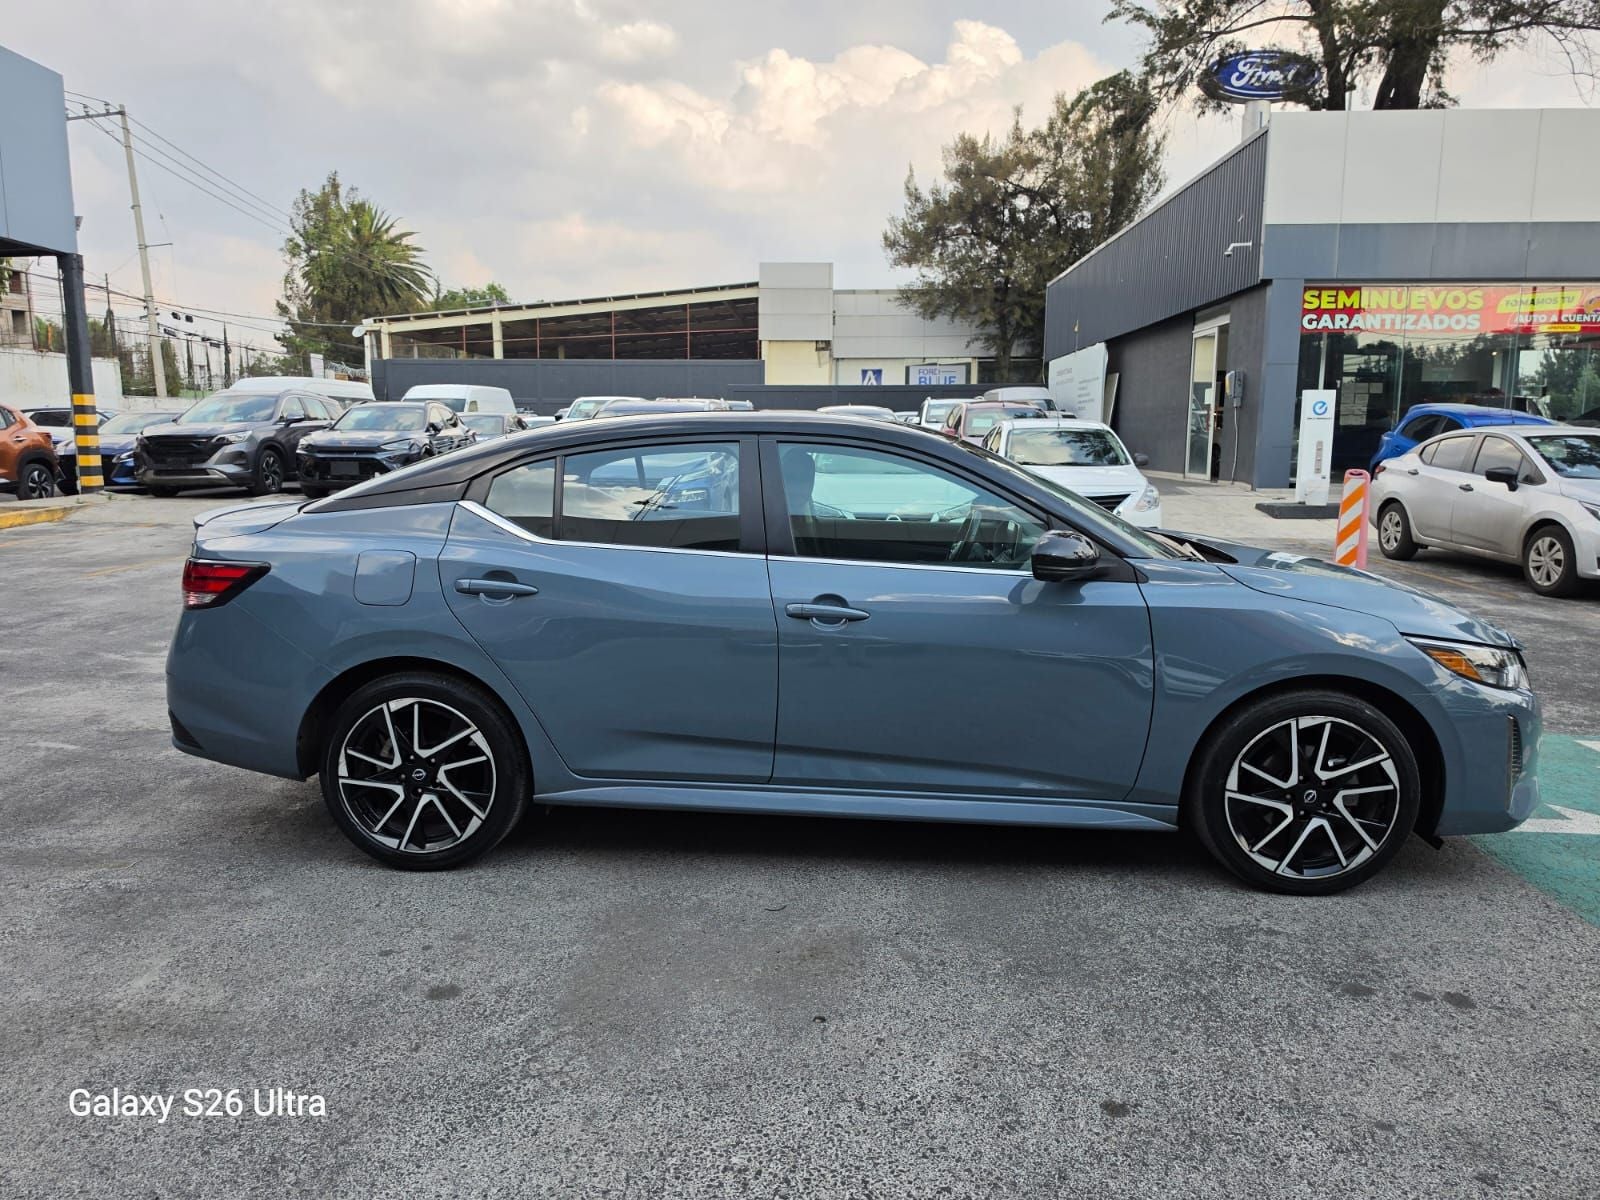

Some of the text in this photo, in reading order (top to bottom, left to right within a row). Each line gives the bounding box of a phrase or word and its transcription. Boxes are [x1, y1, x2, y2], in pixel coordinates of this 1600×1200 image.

[1303, 289, 1484, 310] SEMINUEVOS
[1505, 297, 1558, 307] TOMAMOS
[1302, 313, 1481, 330] GARANTIZADOS
[1515, 313, 1547, 323] AUTO
[1550, 313, 1558, 322] A
